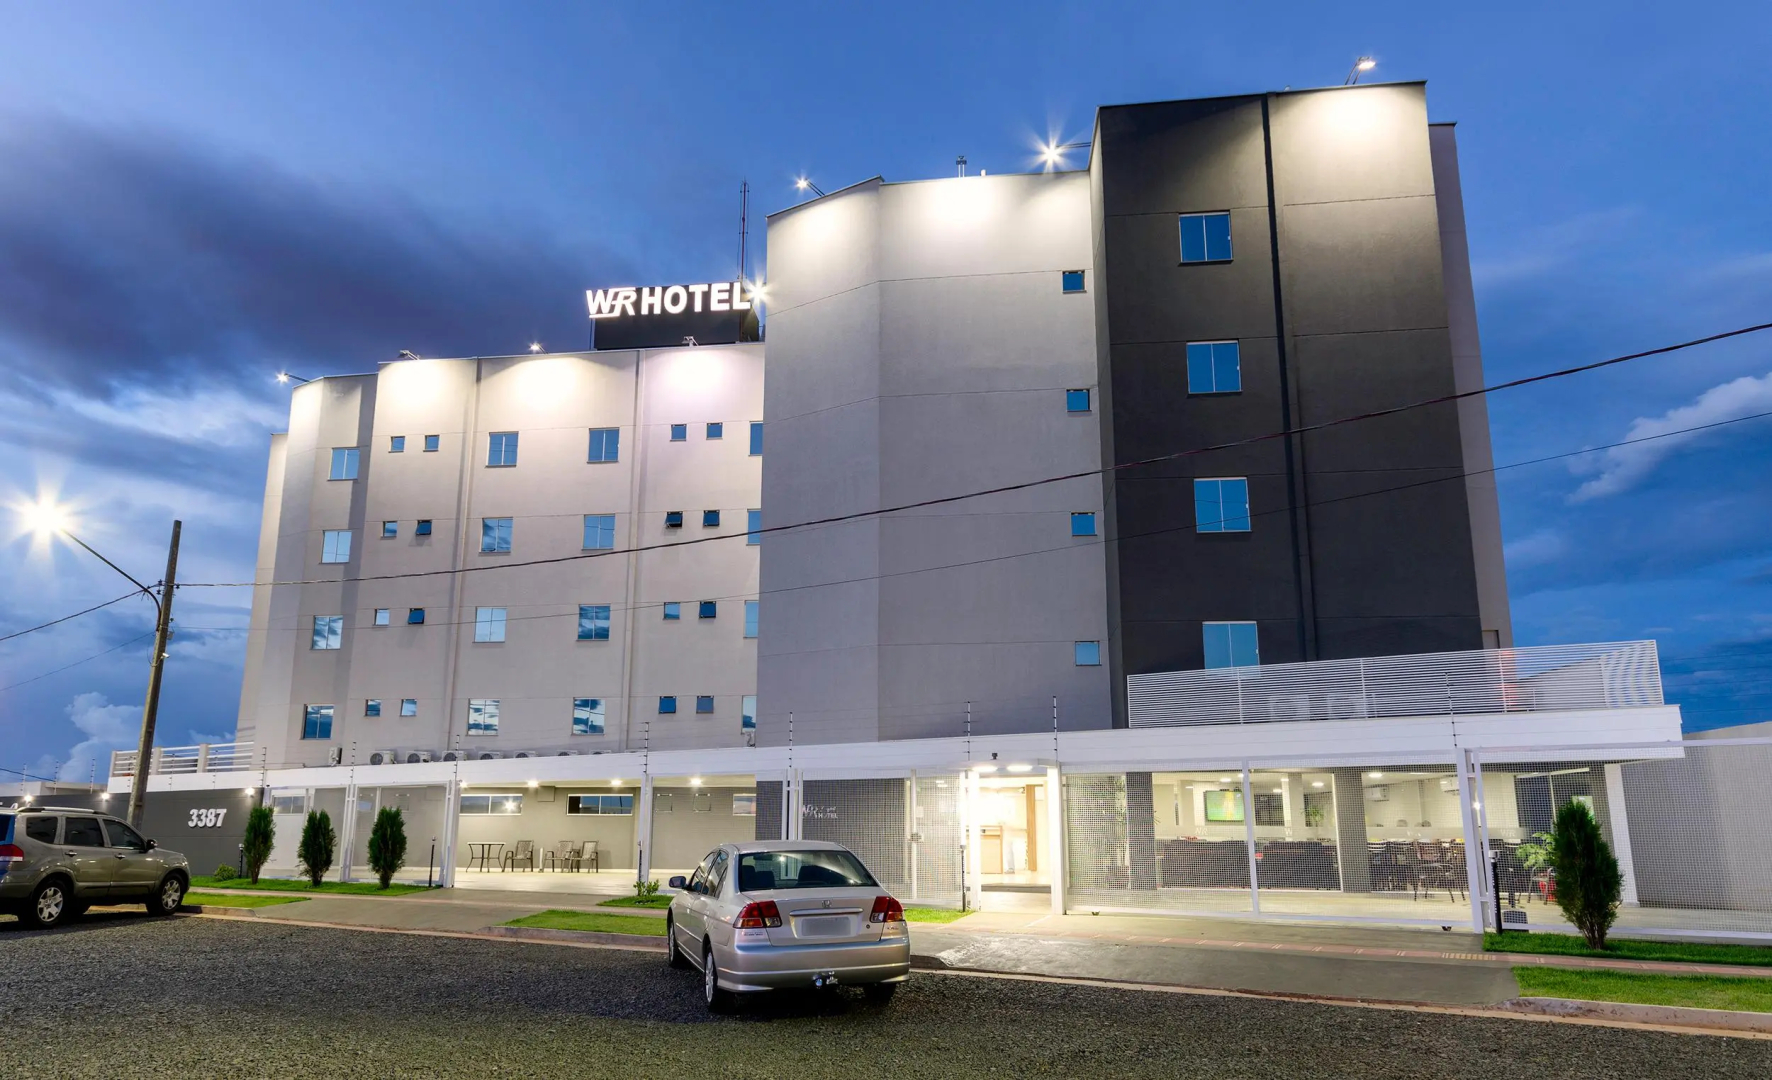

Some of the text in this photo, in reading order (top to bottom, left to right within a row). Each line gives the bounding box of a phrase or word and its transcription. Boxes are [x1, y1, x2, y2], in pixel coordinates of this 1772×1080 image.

[586, 282, 751, 318] WR HOTEL
[188, 808, 227, 828] 3387
